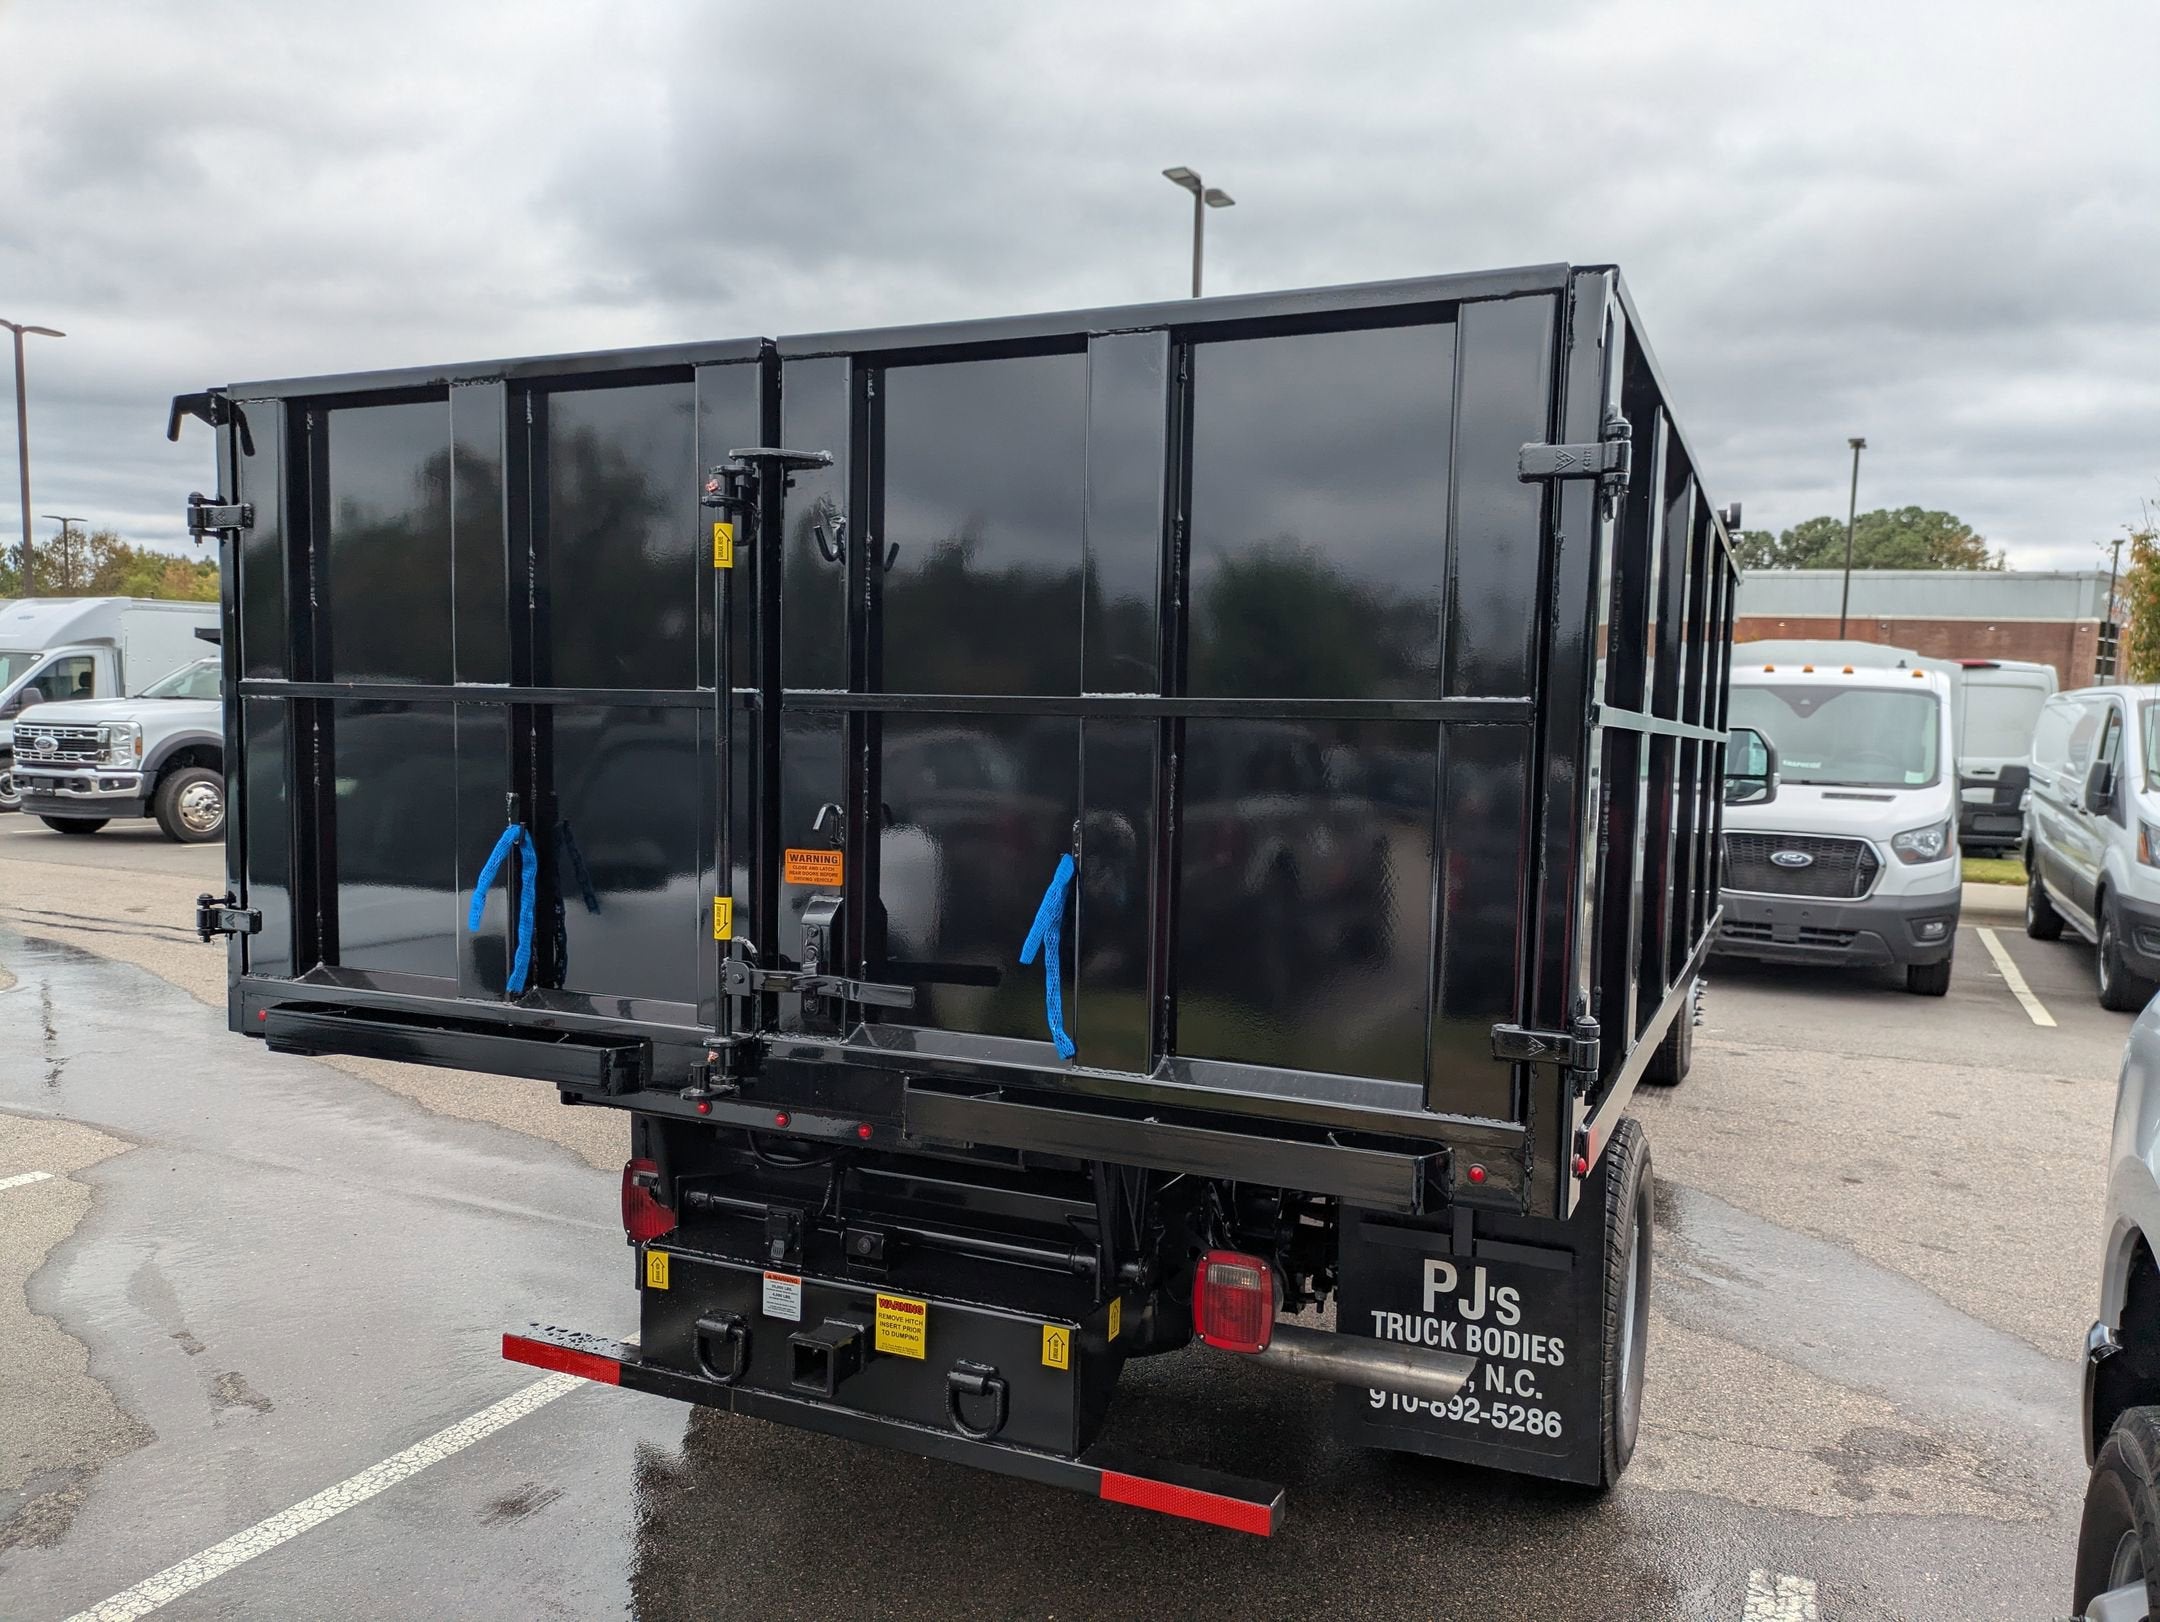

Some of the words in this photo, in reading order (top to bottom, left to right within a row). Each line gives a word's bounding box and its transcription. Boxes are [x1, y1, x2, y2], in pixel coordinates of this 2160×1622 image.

[789, 854, 838, 864] WARNING
[878, 1297, 925, 1316] WARNING
[878, 1312, 905, 1323] REMOVE
[905, 1317, 924, 1326] HITCH
[879, 1321, 902, 1330] INSERT
[902, 1325, 922, 1334] PRIOR
[891, 1331, 919, 1342] DUMPING
[1370, 1310, 1458, 1349] TRUCK
[1465, 1324, 1565, 1367] BODIES
[1484, 1363, 1544, 1400] N.C.
